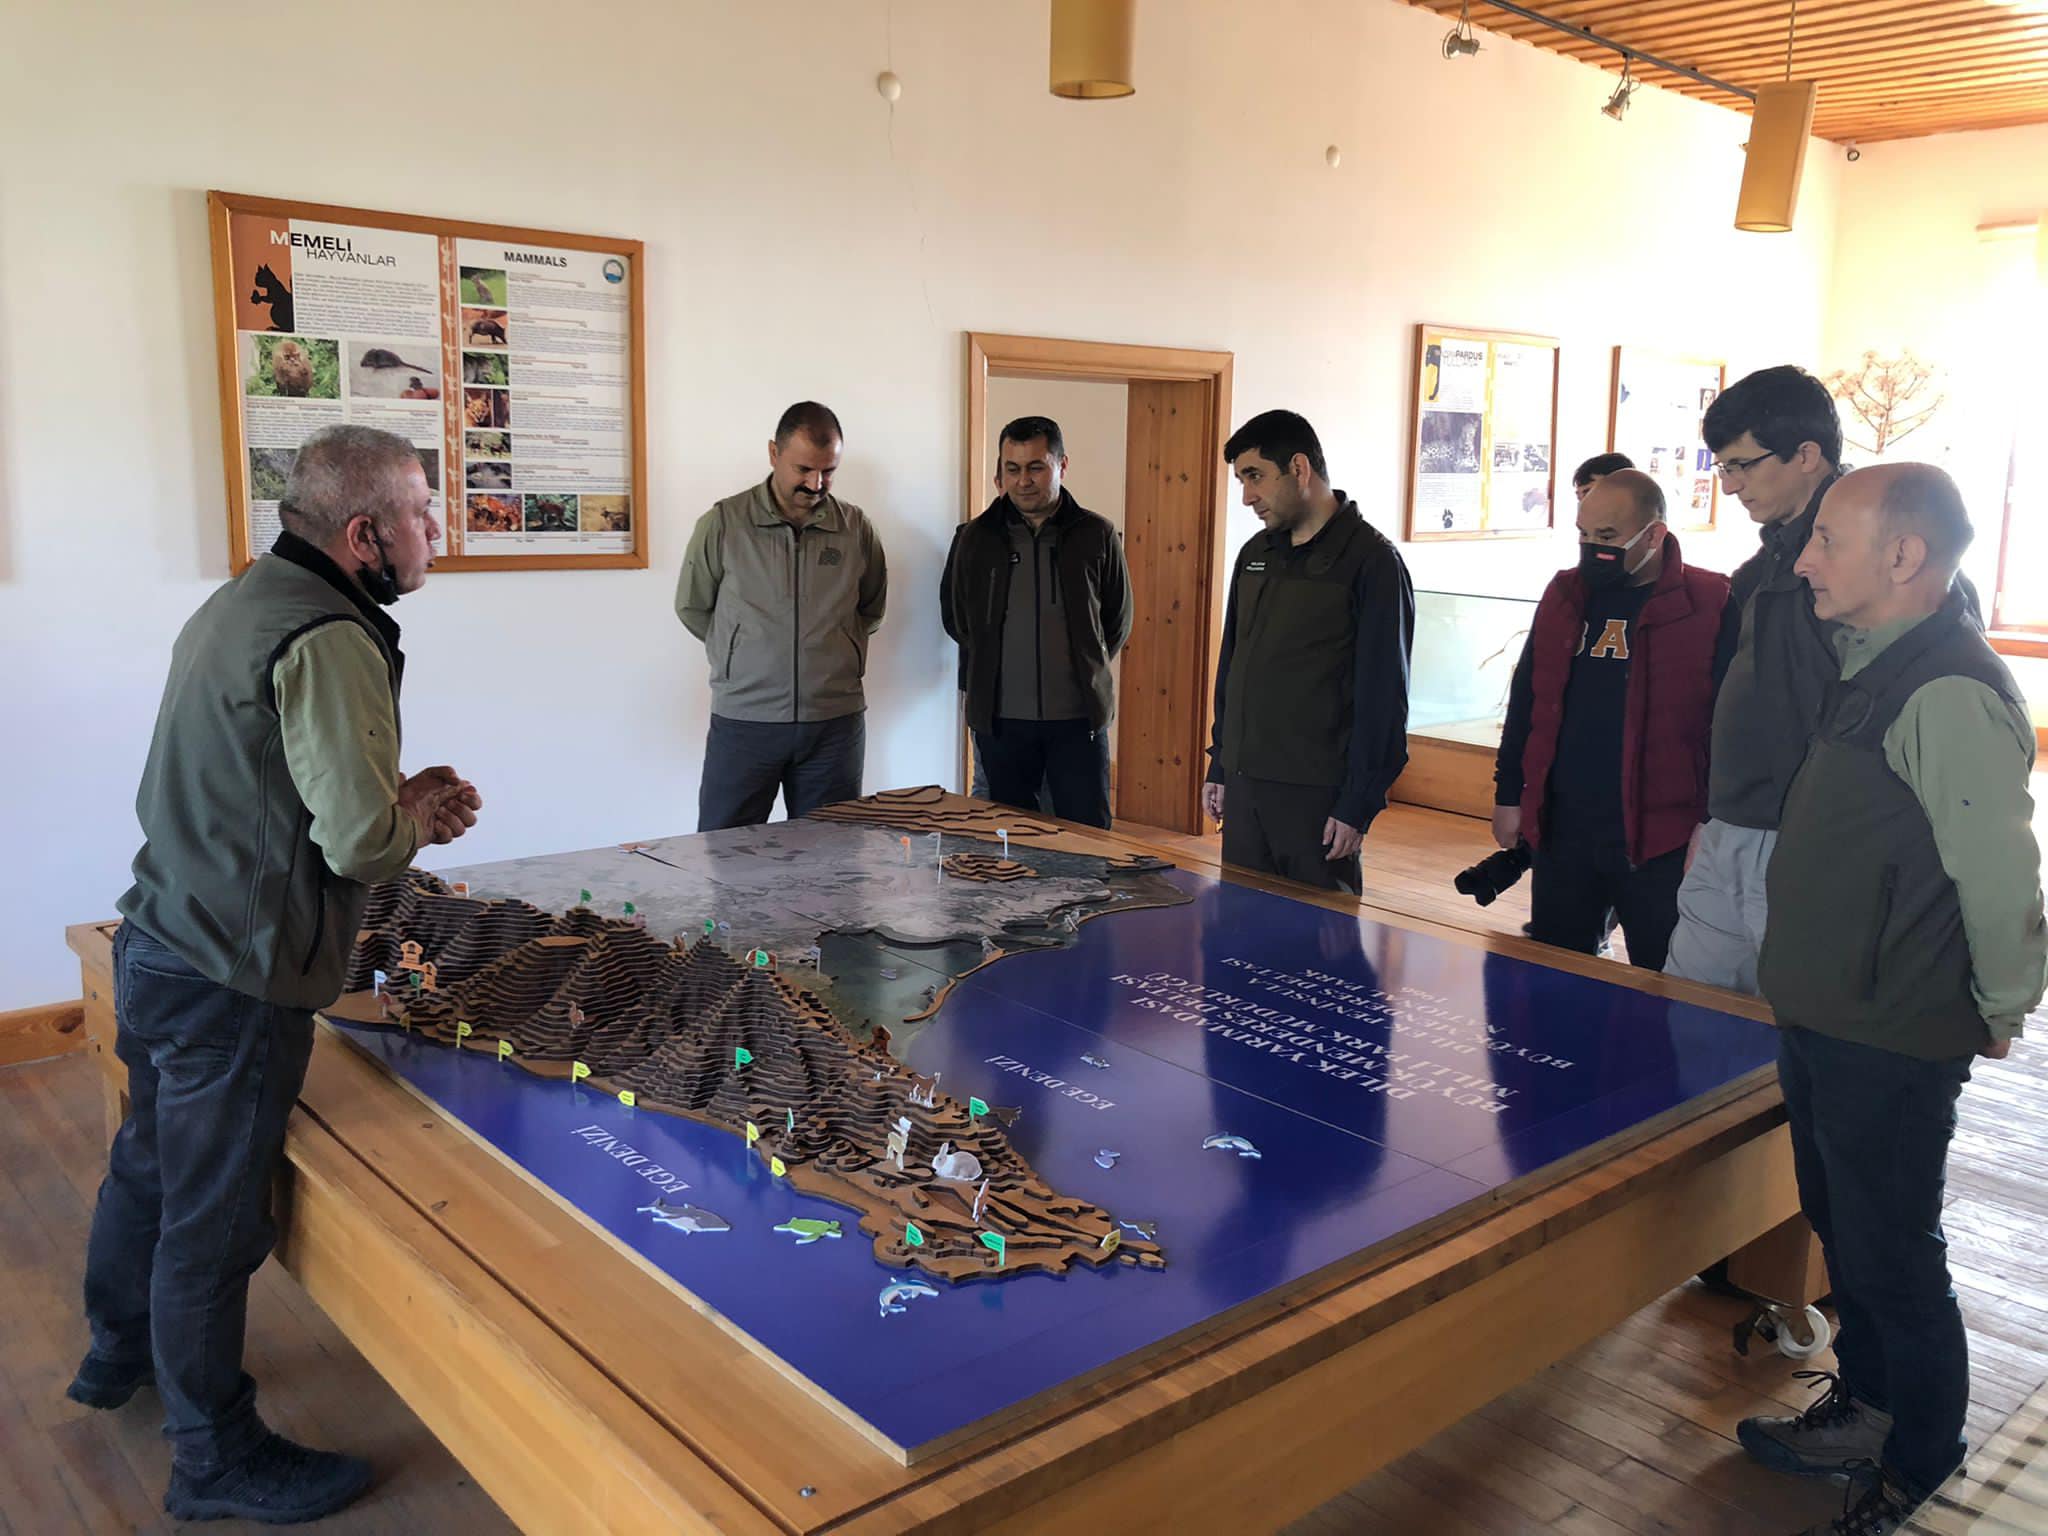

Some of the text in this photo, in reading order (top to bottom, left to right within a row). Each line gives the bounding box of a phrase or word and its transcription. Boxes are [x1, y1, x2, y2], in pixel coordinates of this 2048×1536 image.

[270, 230, 352, 251] MEMELİ
[306, 247, 397, 267] HAYVANLAR
[504, 251, 568, 268] MAMMALS
[1298, 968, 1365, 991] PARK
[1143, 971, 1325, 1034] MÜDÜRLÜĞÜ
[1220, 957, 1576, 1070] BÜYÜK MENDERES DELTASI
[1109, 973, 1512, 1114] BÜYÜK MENDERES DELTASI
[1128, 996, 1416, 1100] DİLEK YARIMADASI
[1319, 1030, 1411, 1063] PARK
[1062, 1086, 1118, 1111] EGE
[570, 1124, 692, 1195] EGE DENİZİ
